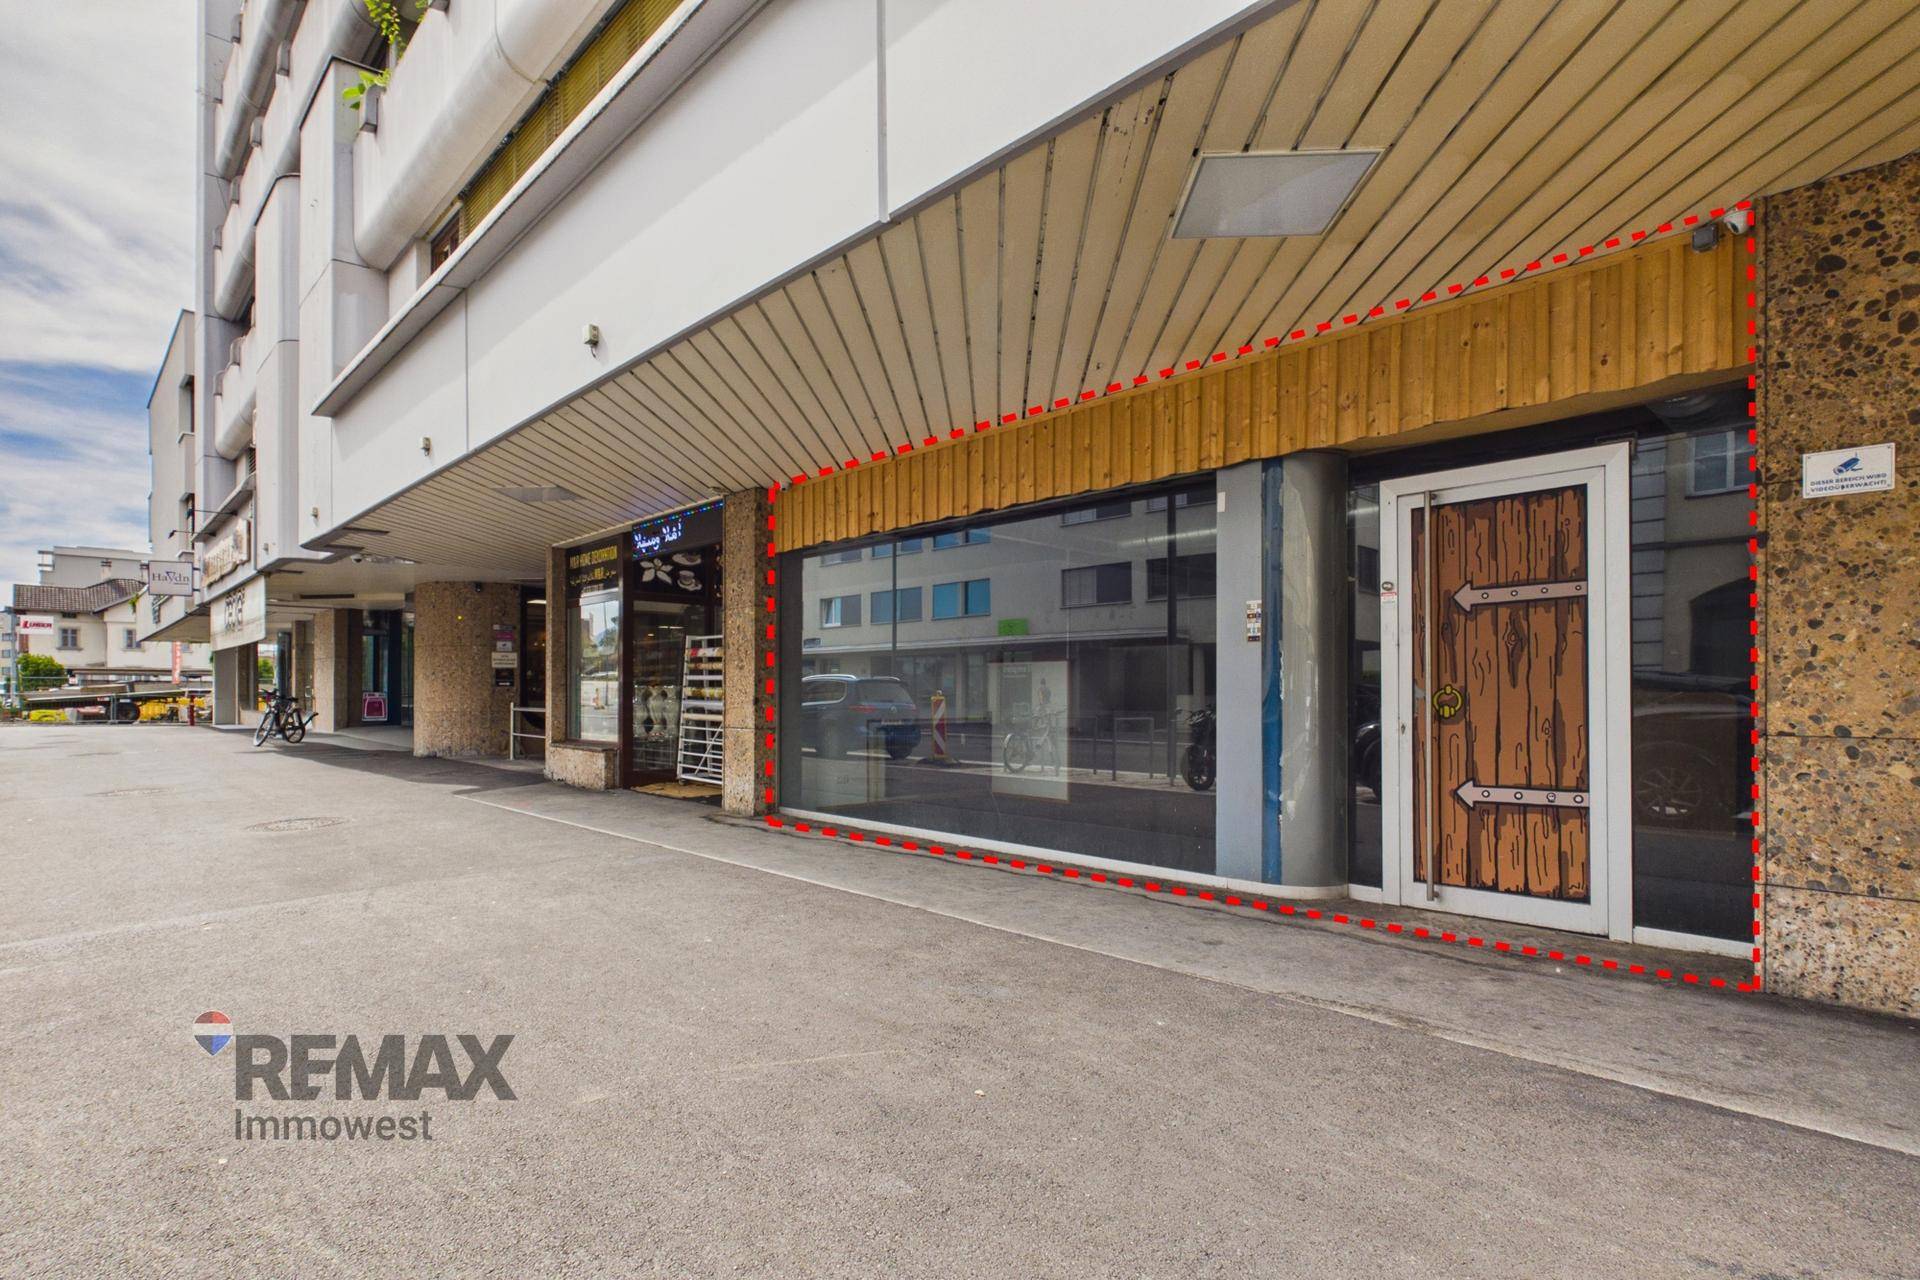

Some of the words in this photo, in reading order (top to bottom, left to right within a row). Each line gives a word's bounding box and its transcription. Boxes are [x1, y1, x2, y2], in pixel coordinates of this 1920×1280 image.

[1810, 478, 1834, 487] DIESER
[1835, 475, 1865, 483] BEREICH
[152, 570, 190, 584] Haydn
